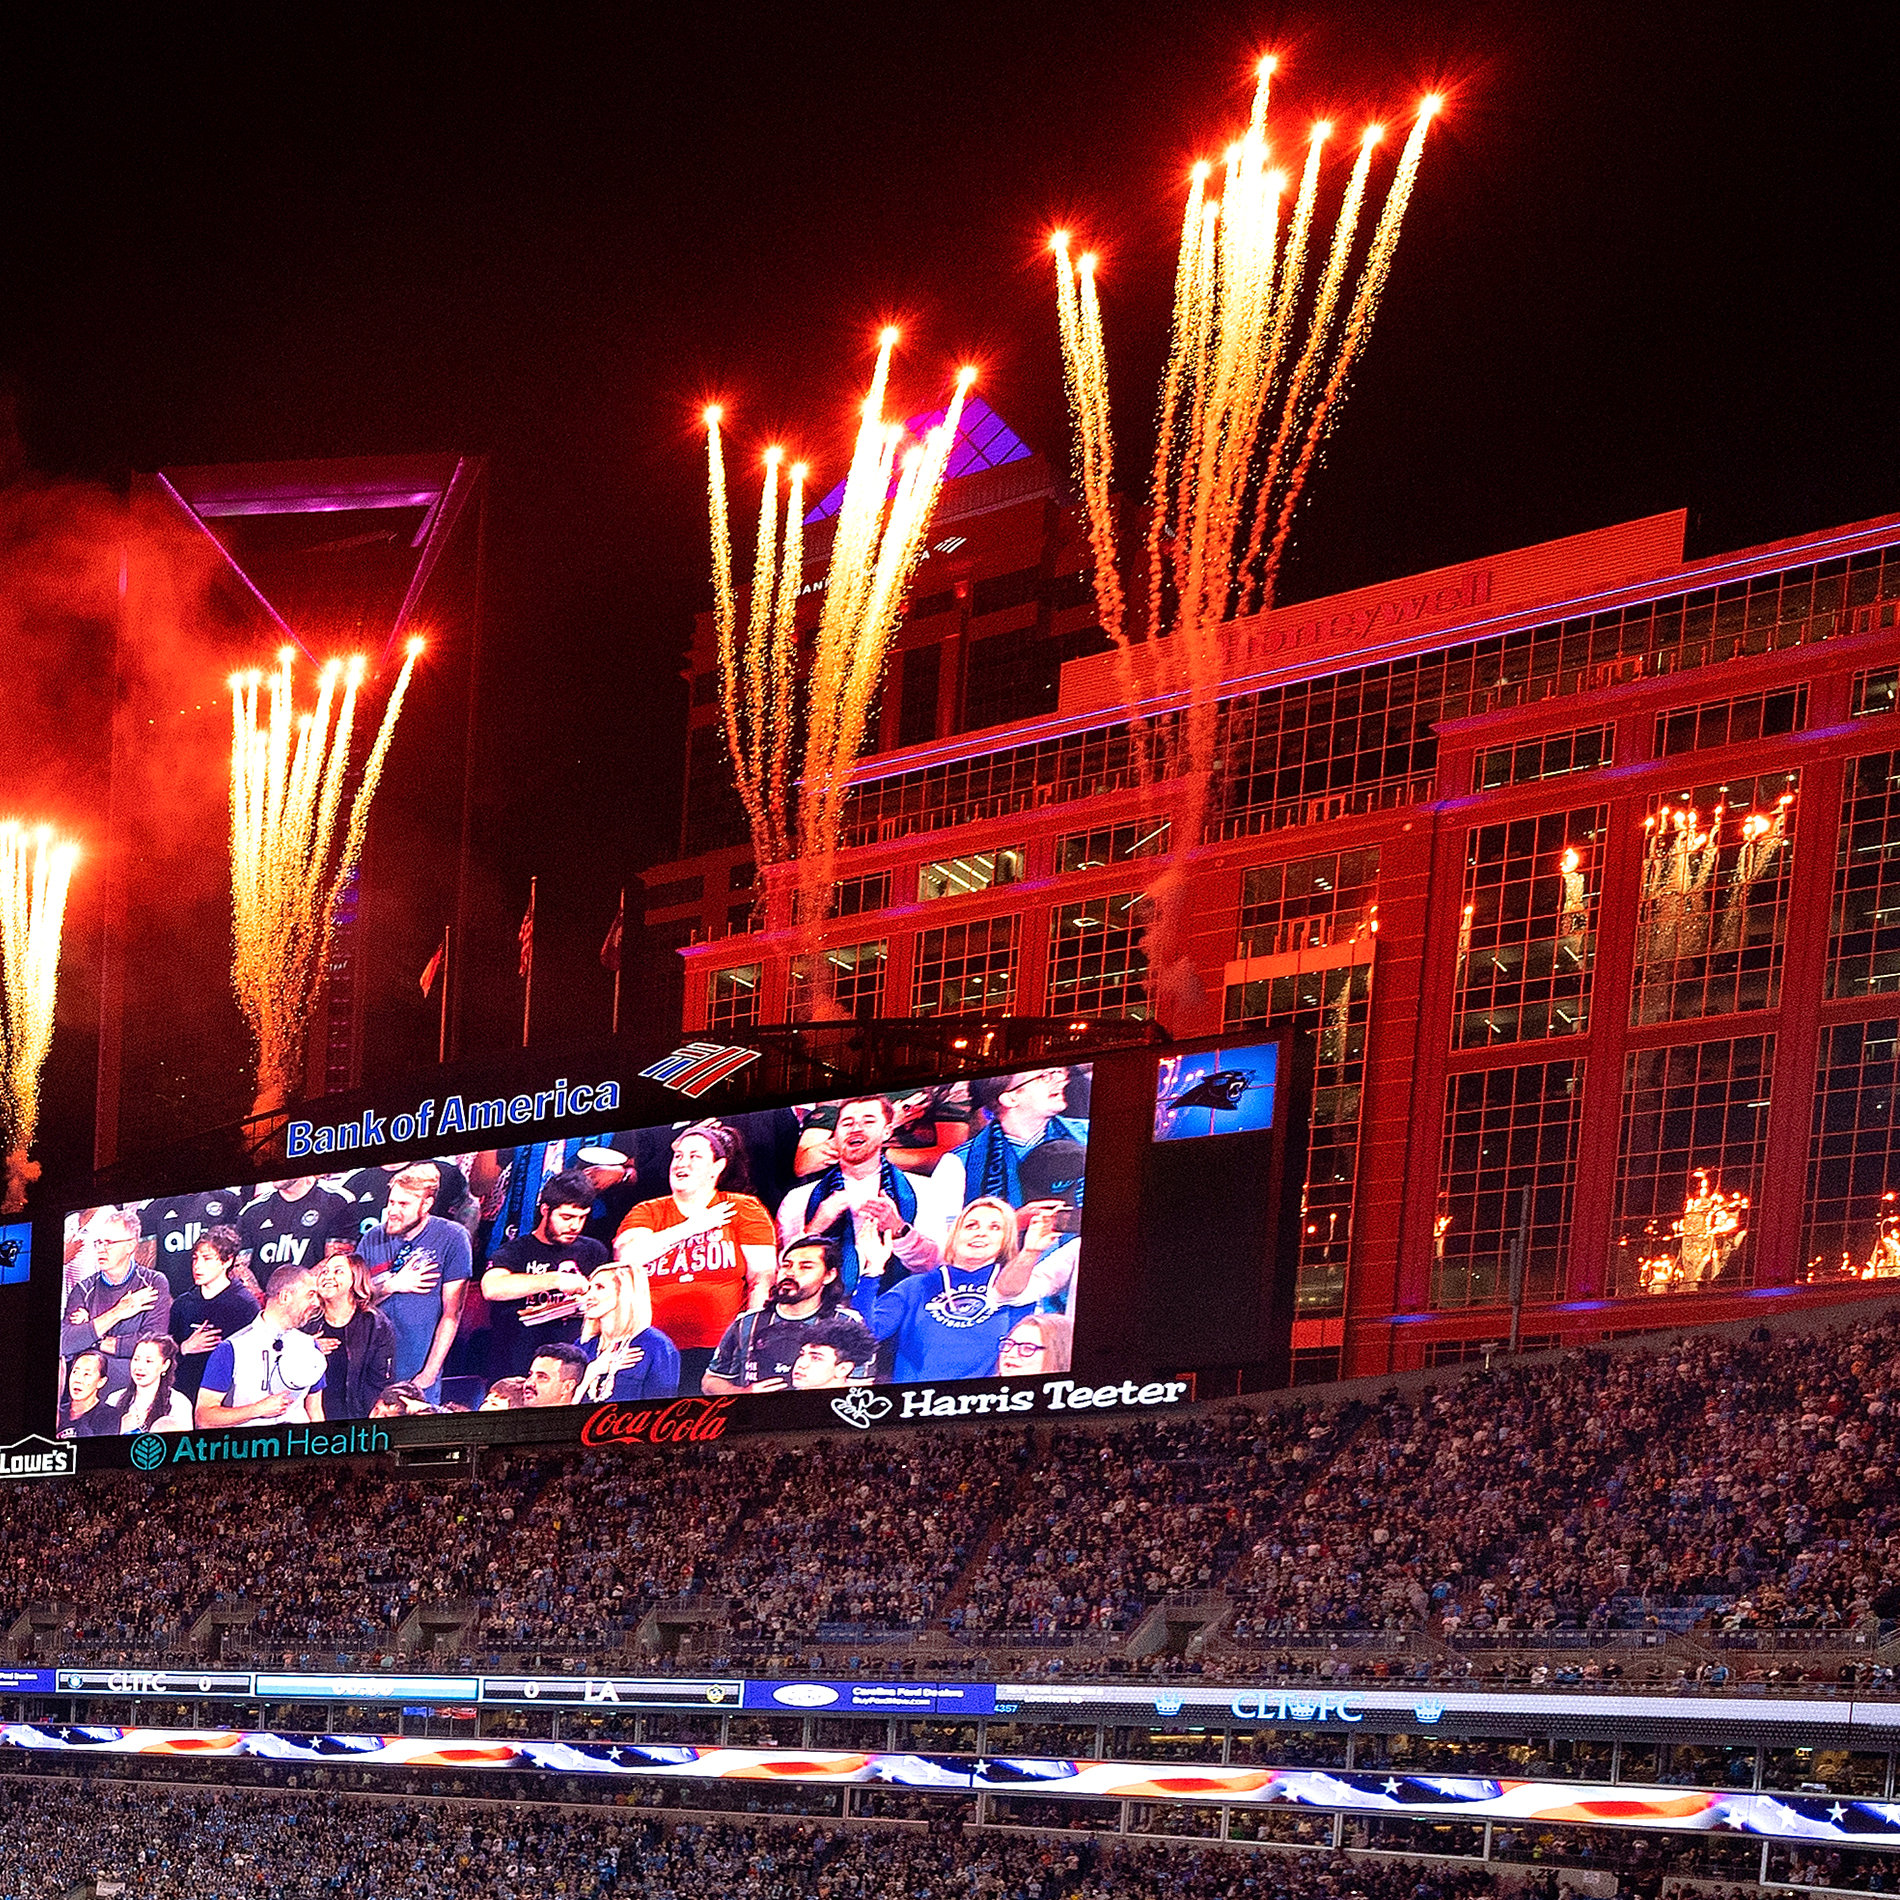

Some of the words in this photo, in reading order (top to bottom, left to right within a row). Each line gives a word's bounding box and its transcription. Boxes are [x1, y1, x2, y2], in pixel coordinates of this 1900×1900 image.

[286, 1109, 393, 1158] Bank
[390, 1098, 435, 1141] of
[437, 1078, 620, 1137] America
[260, 1234, 310, 1265] ally
[900, 1386, 1035, 1419] Harris
[1044, 1379, 1187, 1410] Teeter
[581, 1396, 738, 1447] Coca-Cola
[0, 1449, 68, 1474] LOWE'S
[173, 1435, 280, 1463] Atrium
[287, 1426, 390, 1457] Health
[584, 1680, 620, 1702] LA
